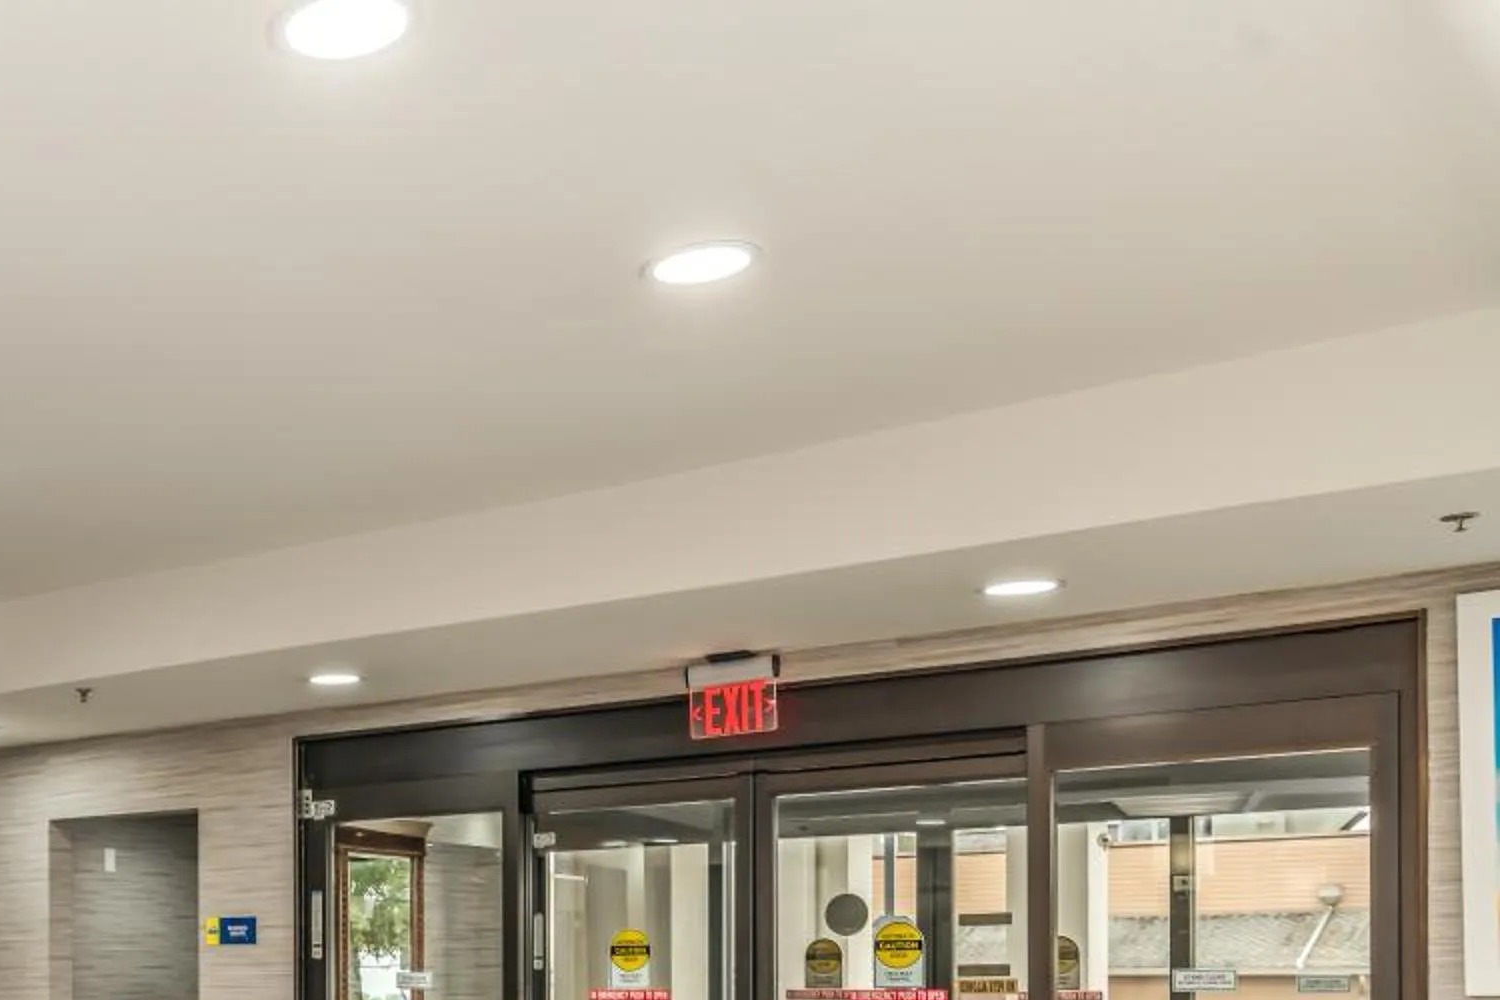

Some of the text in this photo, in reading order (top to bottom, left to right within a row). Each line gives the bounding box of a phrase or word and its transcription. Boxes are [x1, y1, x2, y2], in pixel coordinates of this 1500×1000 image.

[704, 679, 765, 736] EXIT
[630, 991, 644, 1000] PUSH
[645, 991, 653, 1000] TO
[654, 991, 668, 1000] OPEN
[897, 991, 916, 1000] PUSH
[918, 991, 926, 1000] TO
[927, 991, 945, 1000] OPEN
